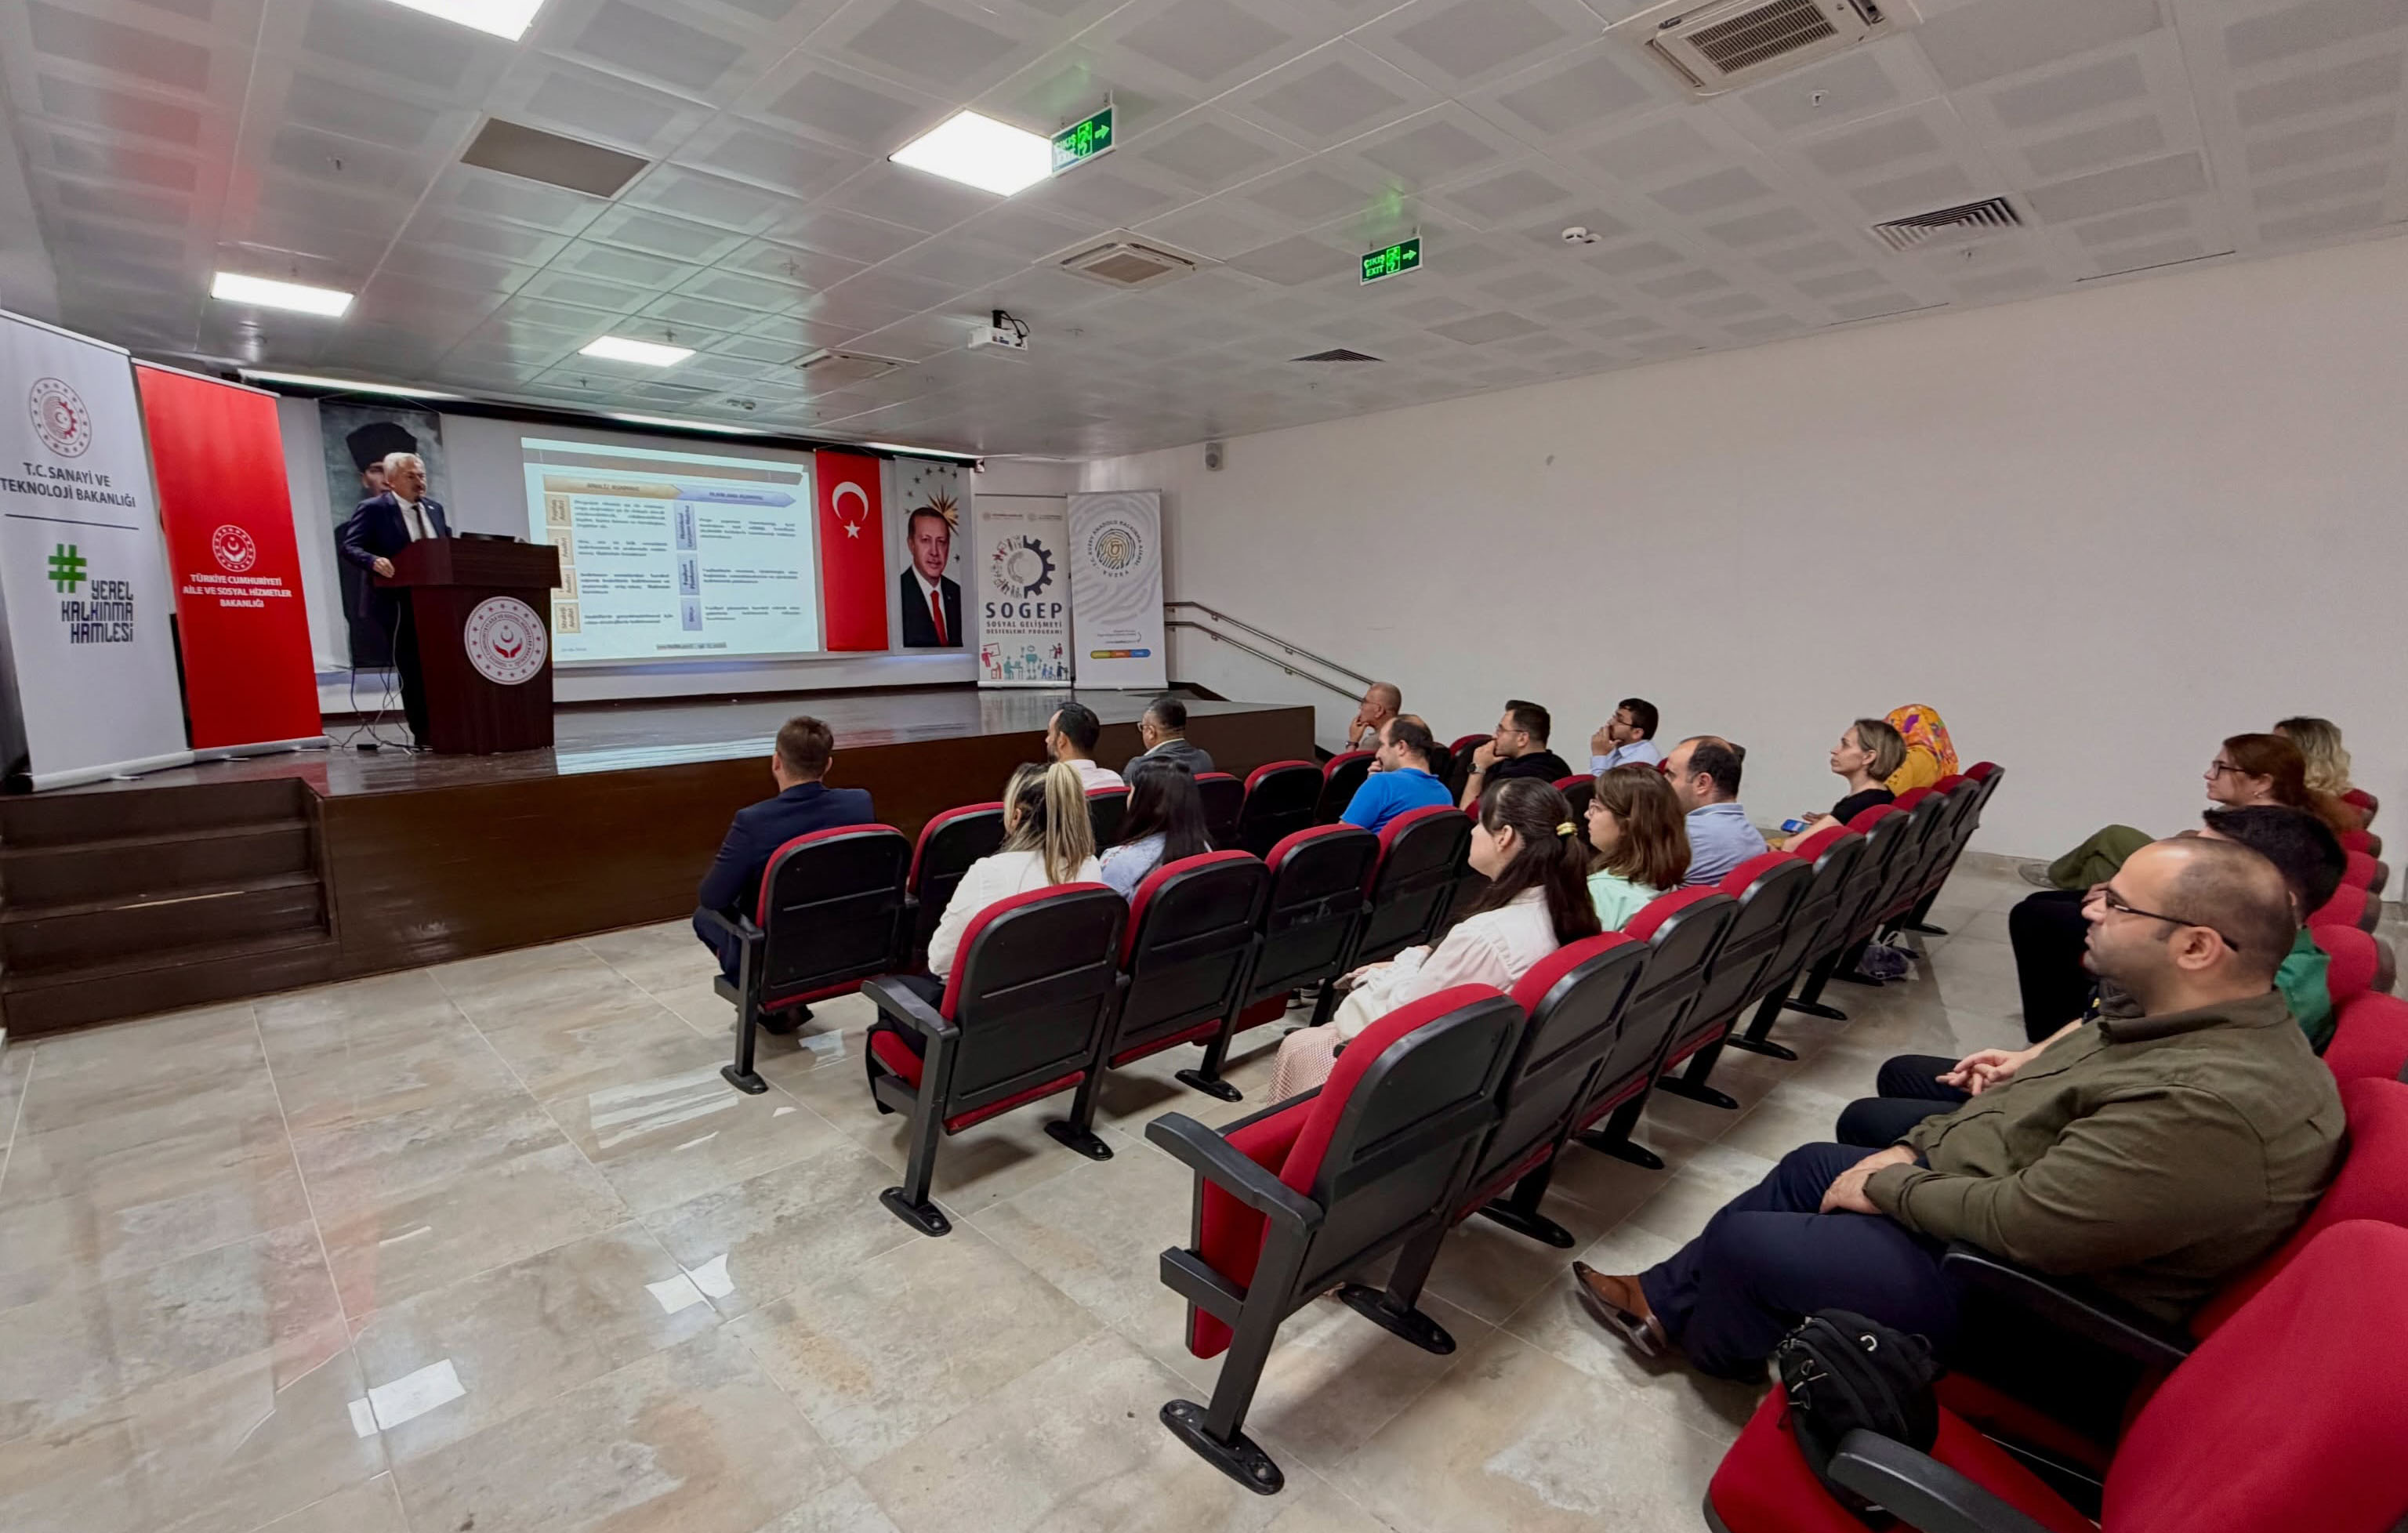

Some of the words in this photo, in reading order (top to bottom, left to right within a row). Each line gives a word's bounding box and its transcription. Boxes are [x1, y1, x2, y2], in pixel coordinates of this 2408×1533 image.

[1366, 265, 1384, 277] EXIT
[23, 462, 47, 477] T.C.
[48, 466, 93, 485] SANAYİ
[95, 473, 111, 487] VE
[0, 477, 74, 499] TEKNOLOJİ
[76, 488, 136, 507] BAKANLIĞI
[92, 580, 133, 600] YEREL
[62, 600, 133, 622] KALKINMA
[985, 602, 1062, 618] SOGEP
[71, 622, 133, 643] HAMLESİ
